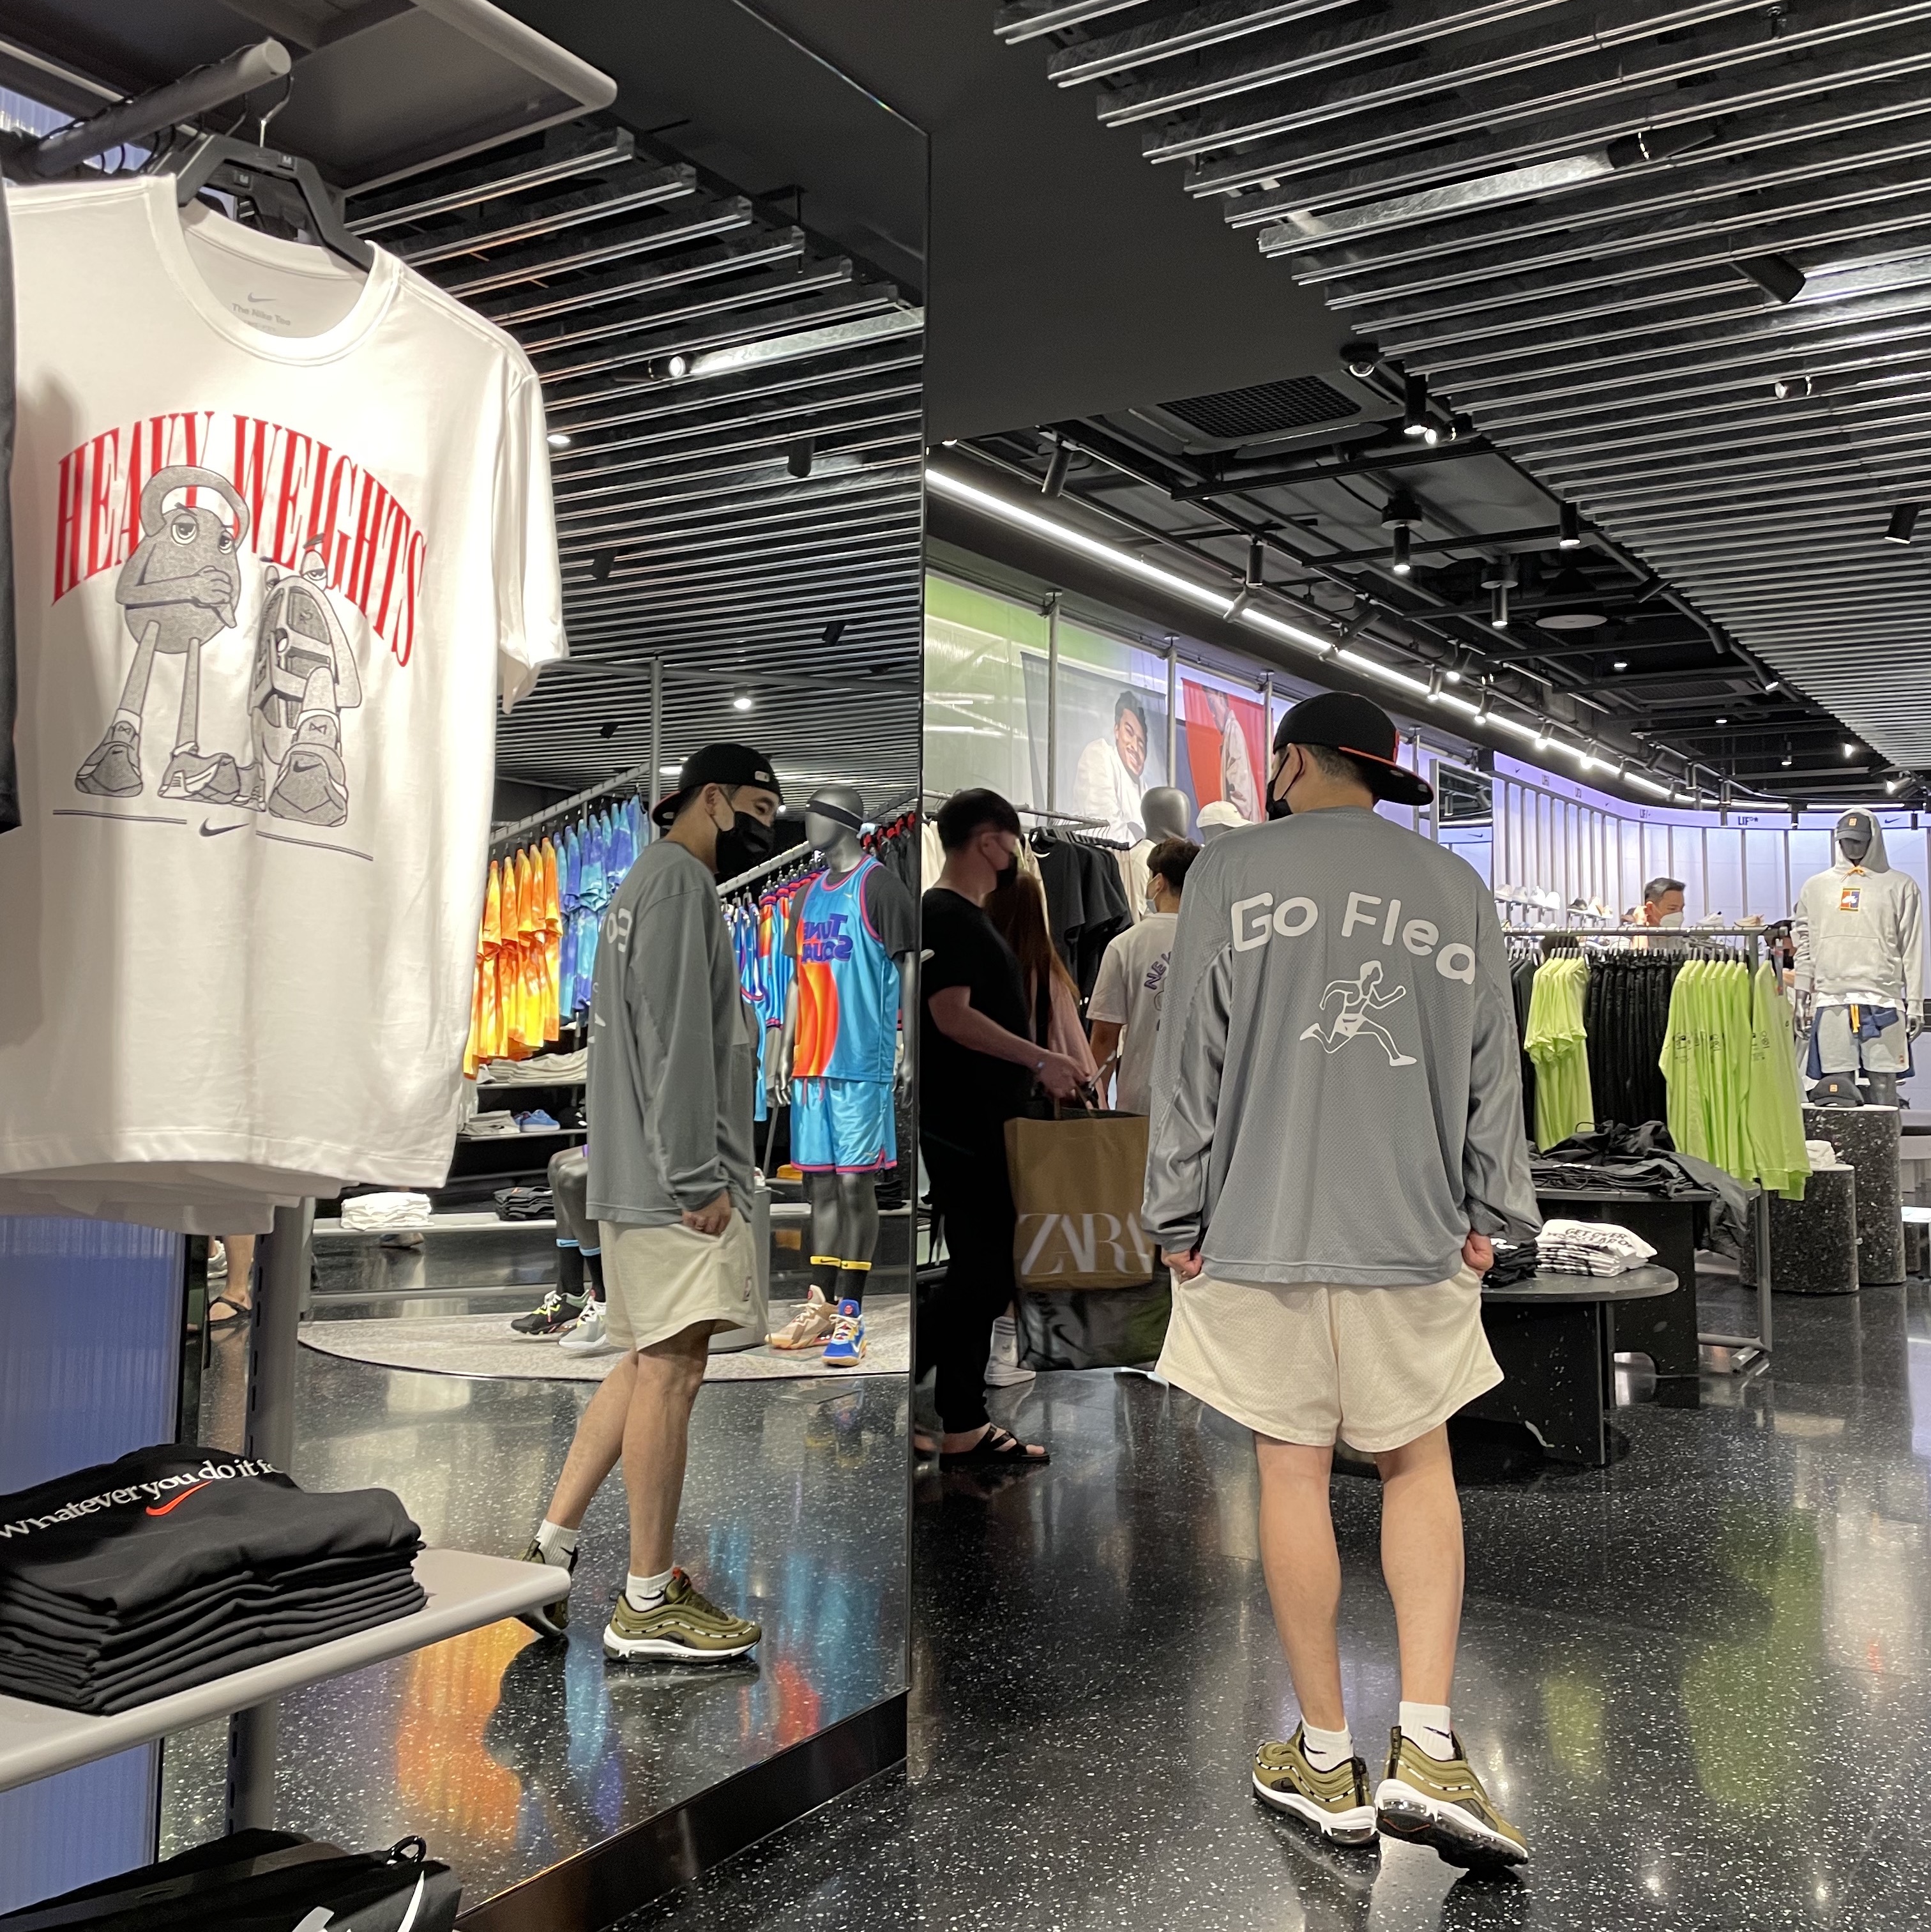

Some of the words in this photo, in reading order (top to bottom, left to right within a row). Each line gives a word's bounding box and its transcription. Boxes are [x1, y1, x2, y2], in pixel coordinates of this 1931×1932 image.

[52, 411, 215, 606] HEAVY
[232, 414, 427, 667] WEIGHTS
[1231, 892, 1319, 952] Go
[1341, 892, 1476, 985] Flea
[1019, 1213, 1153, 1275] ZARA
[0, 1485, 142, 1539] whatever
[139, 1472, 201, 1500] you
[198, 1459, 236, 1480] do
[234, 1459, 259, 1477] it
